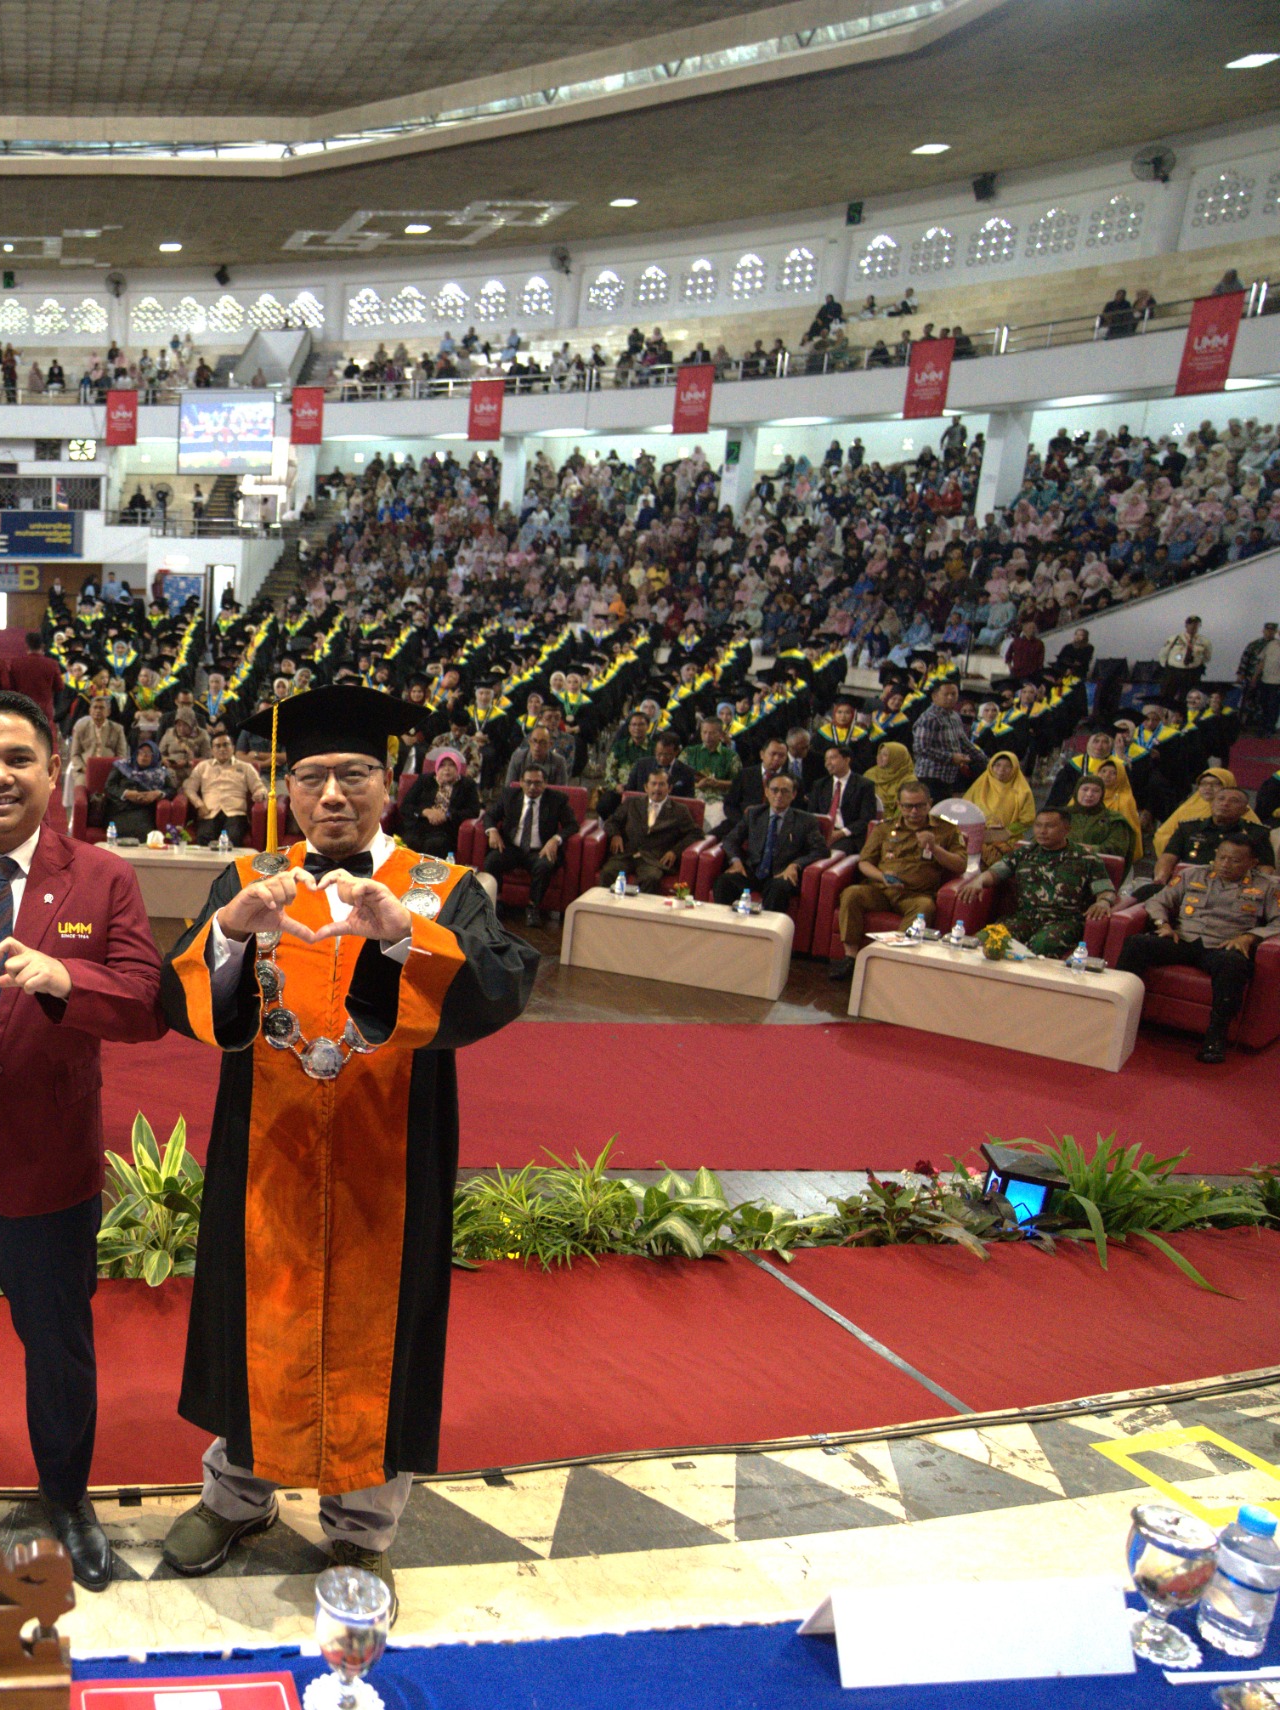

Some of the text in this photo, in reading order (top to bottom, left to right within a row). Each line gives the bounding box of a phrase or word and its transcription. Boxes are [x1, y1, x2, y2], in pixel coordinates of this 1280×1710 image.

[1193, 333, 1229, 352] UMM
[19, 565, 40, 590] B
[58, 921, 92, 935] UMM
